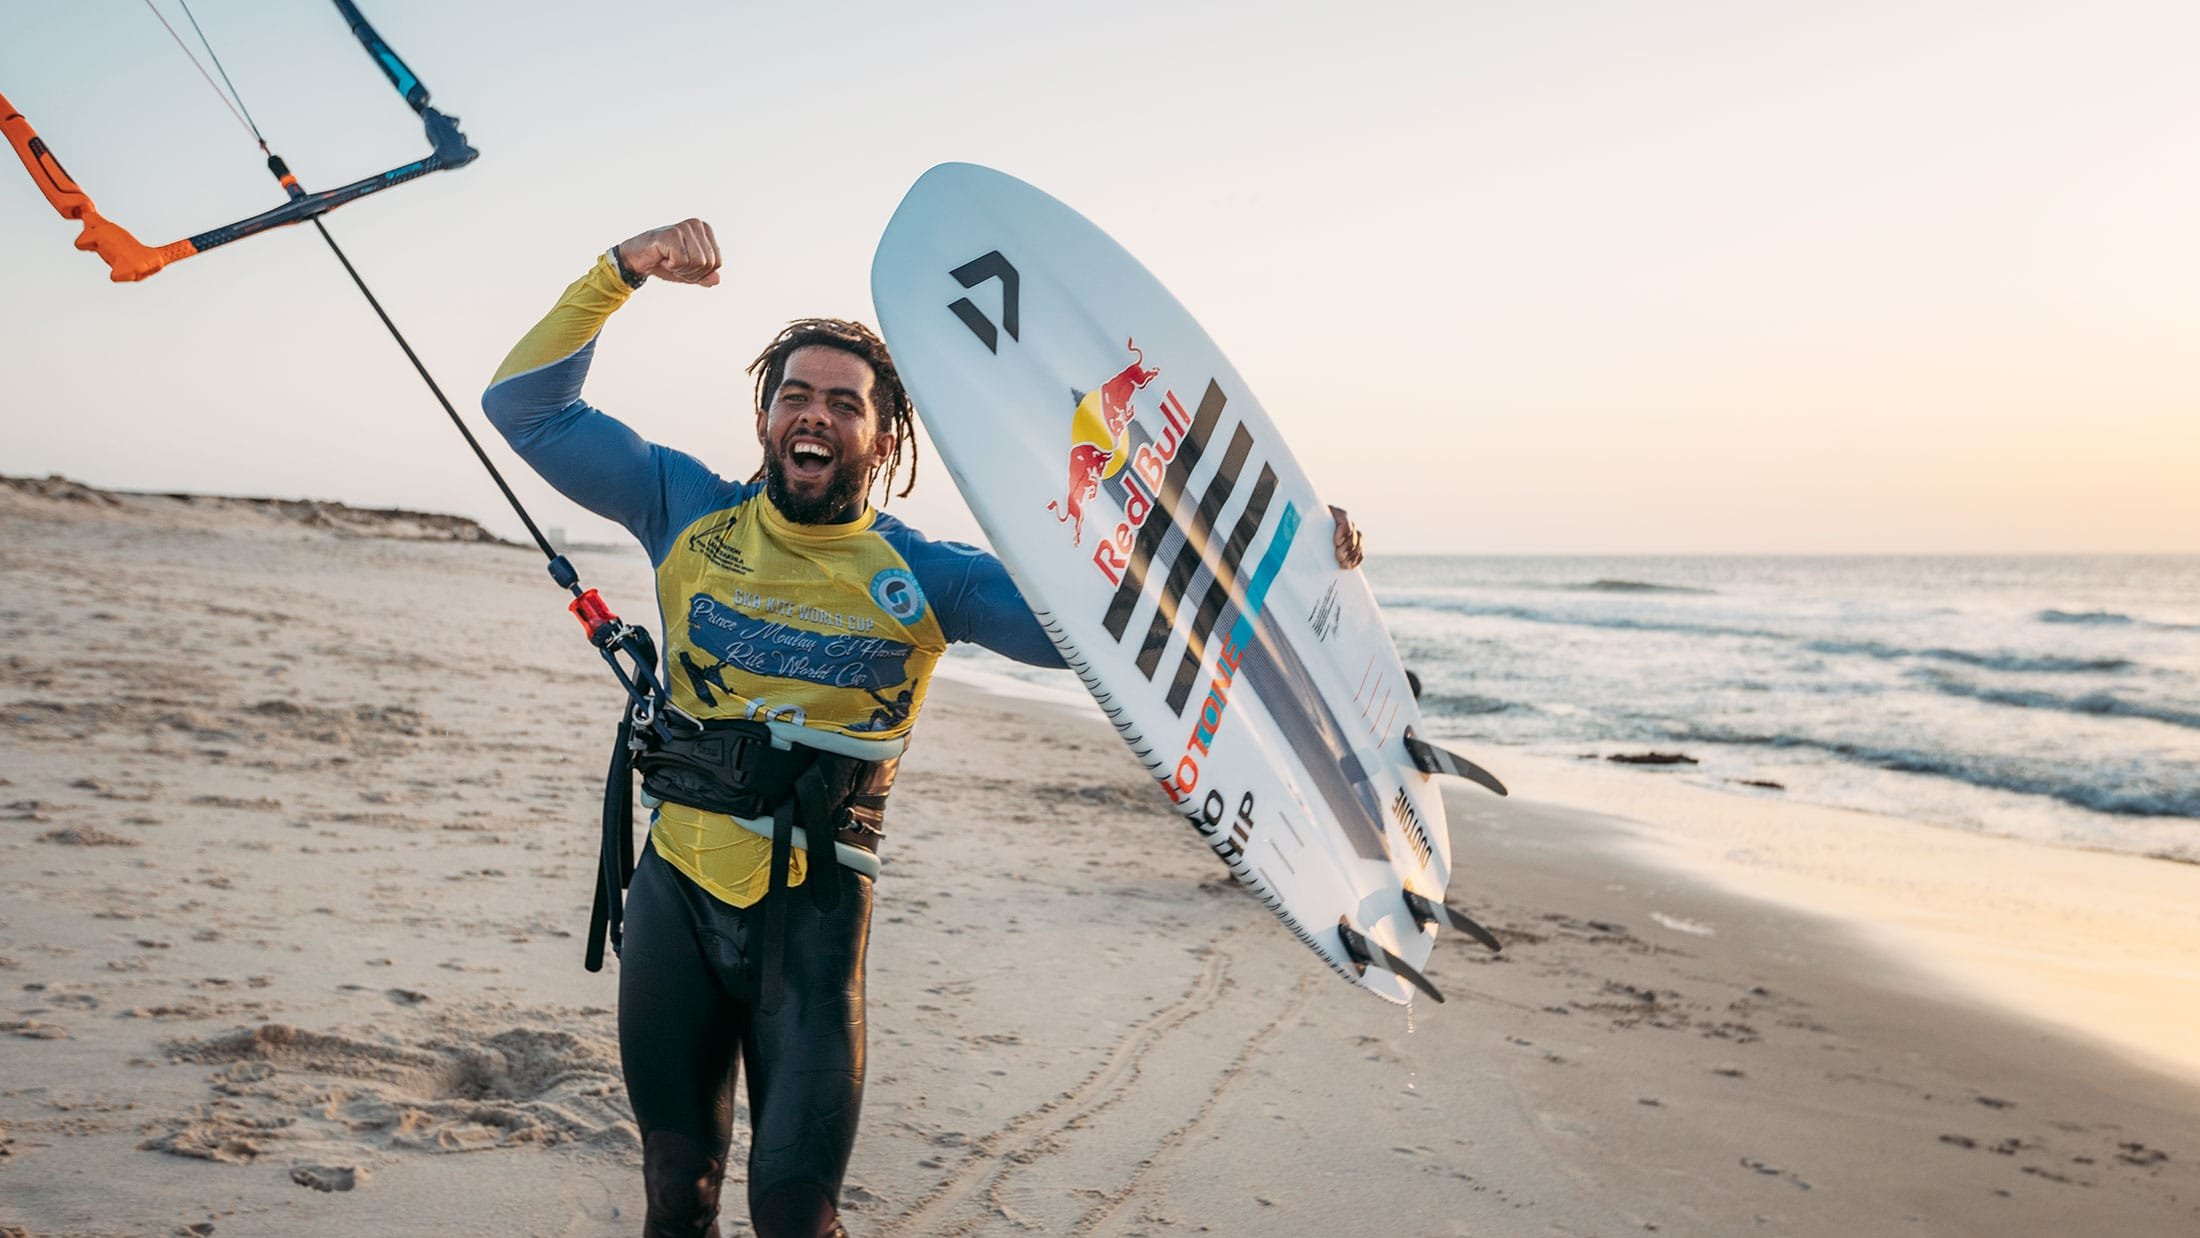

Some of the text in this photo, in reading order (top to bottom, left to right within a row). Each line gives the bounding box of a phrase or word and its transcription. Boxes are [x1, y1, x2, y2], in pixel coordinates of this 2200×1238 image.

[1093, 390, 1192, 587] Red Bull
[693, 598, 738, 631] Prince
[739, 620, 817, 653] Moulay
[765, 596, 795, 618] KITE
[799, 603, 843, 628] WORLD
[847, 615, 876, 633] CUP
[771, 649, 835, 680] World
